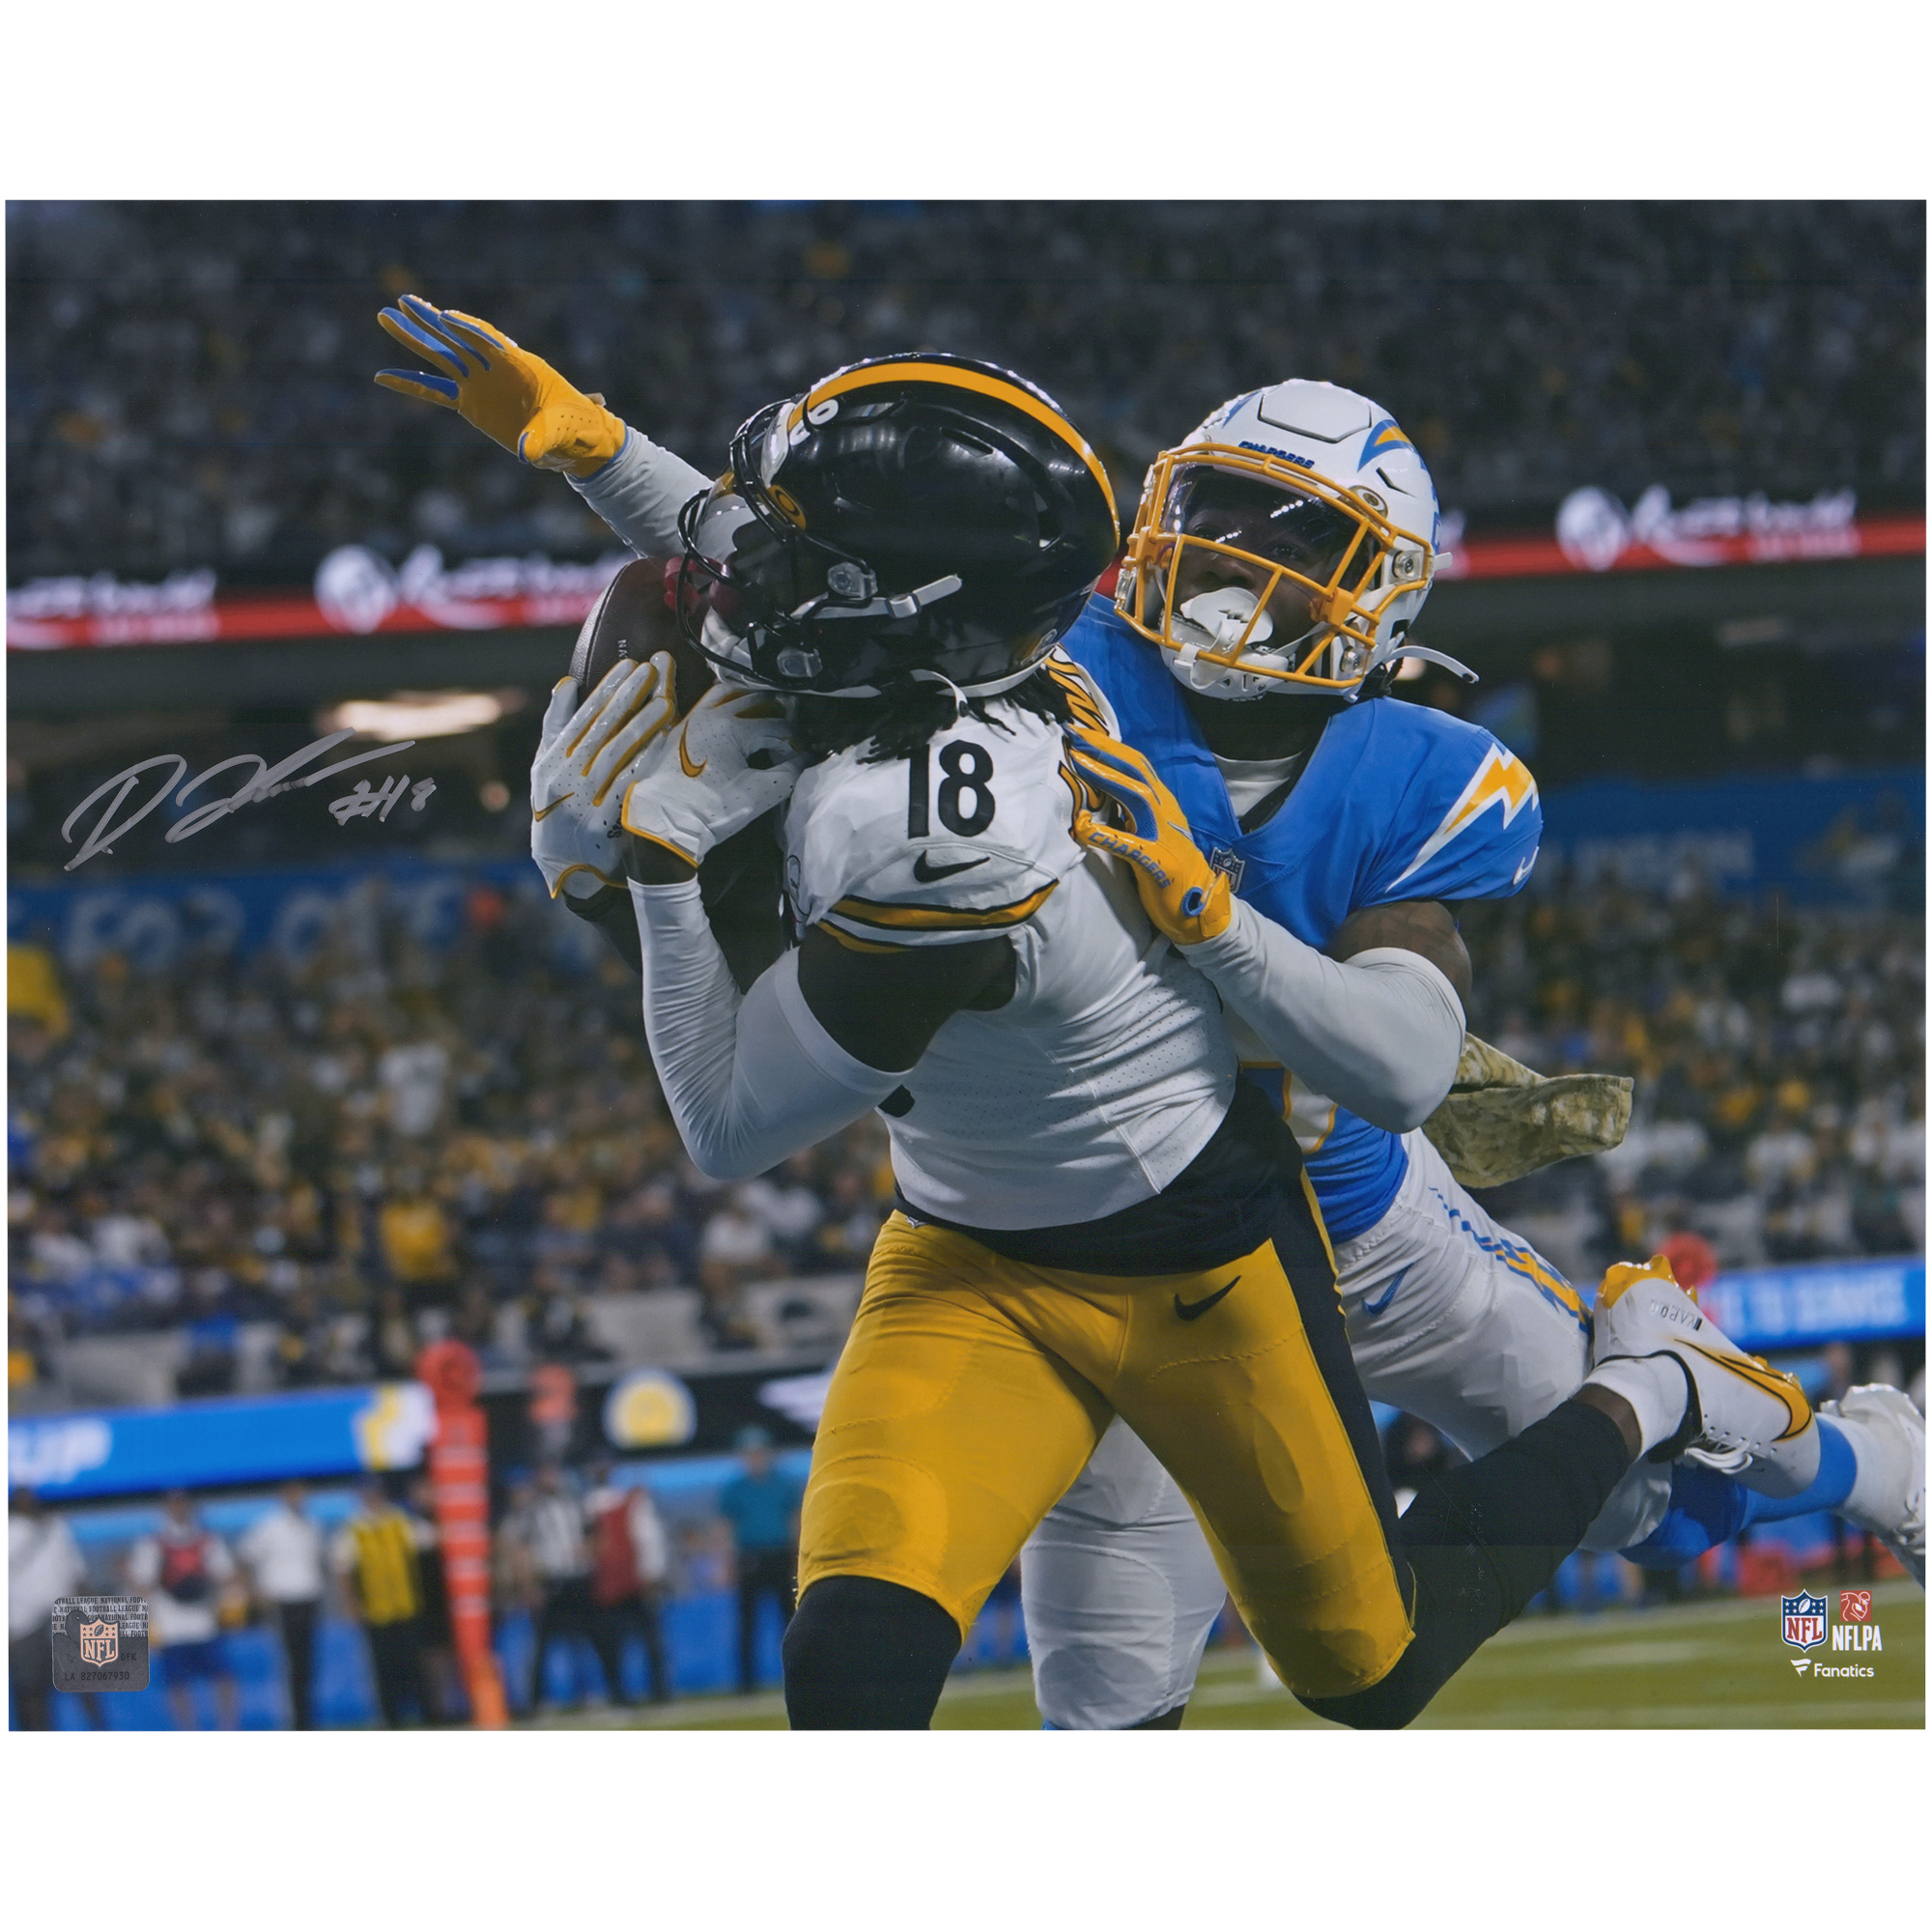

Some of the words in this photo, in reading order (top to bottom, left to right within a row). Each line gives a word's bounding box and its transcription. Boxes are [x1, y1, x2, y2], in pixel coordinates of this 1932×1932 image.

[907, 739, 996, 839] 18
[1089, 832, 1171, 889] CHARGERS
[84, 1639, 115, 1662] NFL
[65, 1673, 75, 1682] LA
[80, 1671, 130, 1681] 827067930
